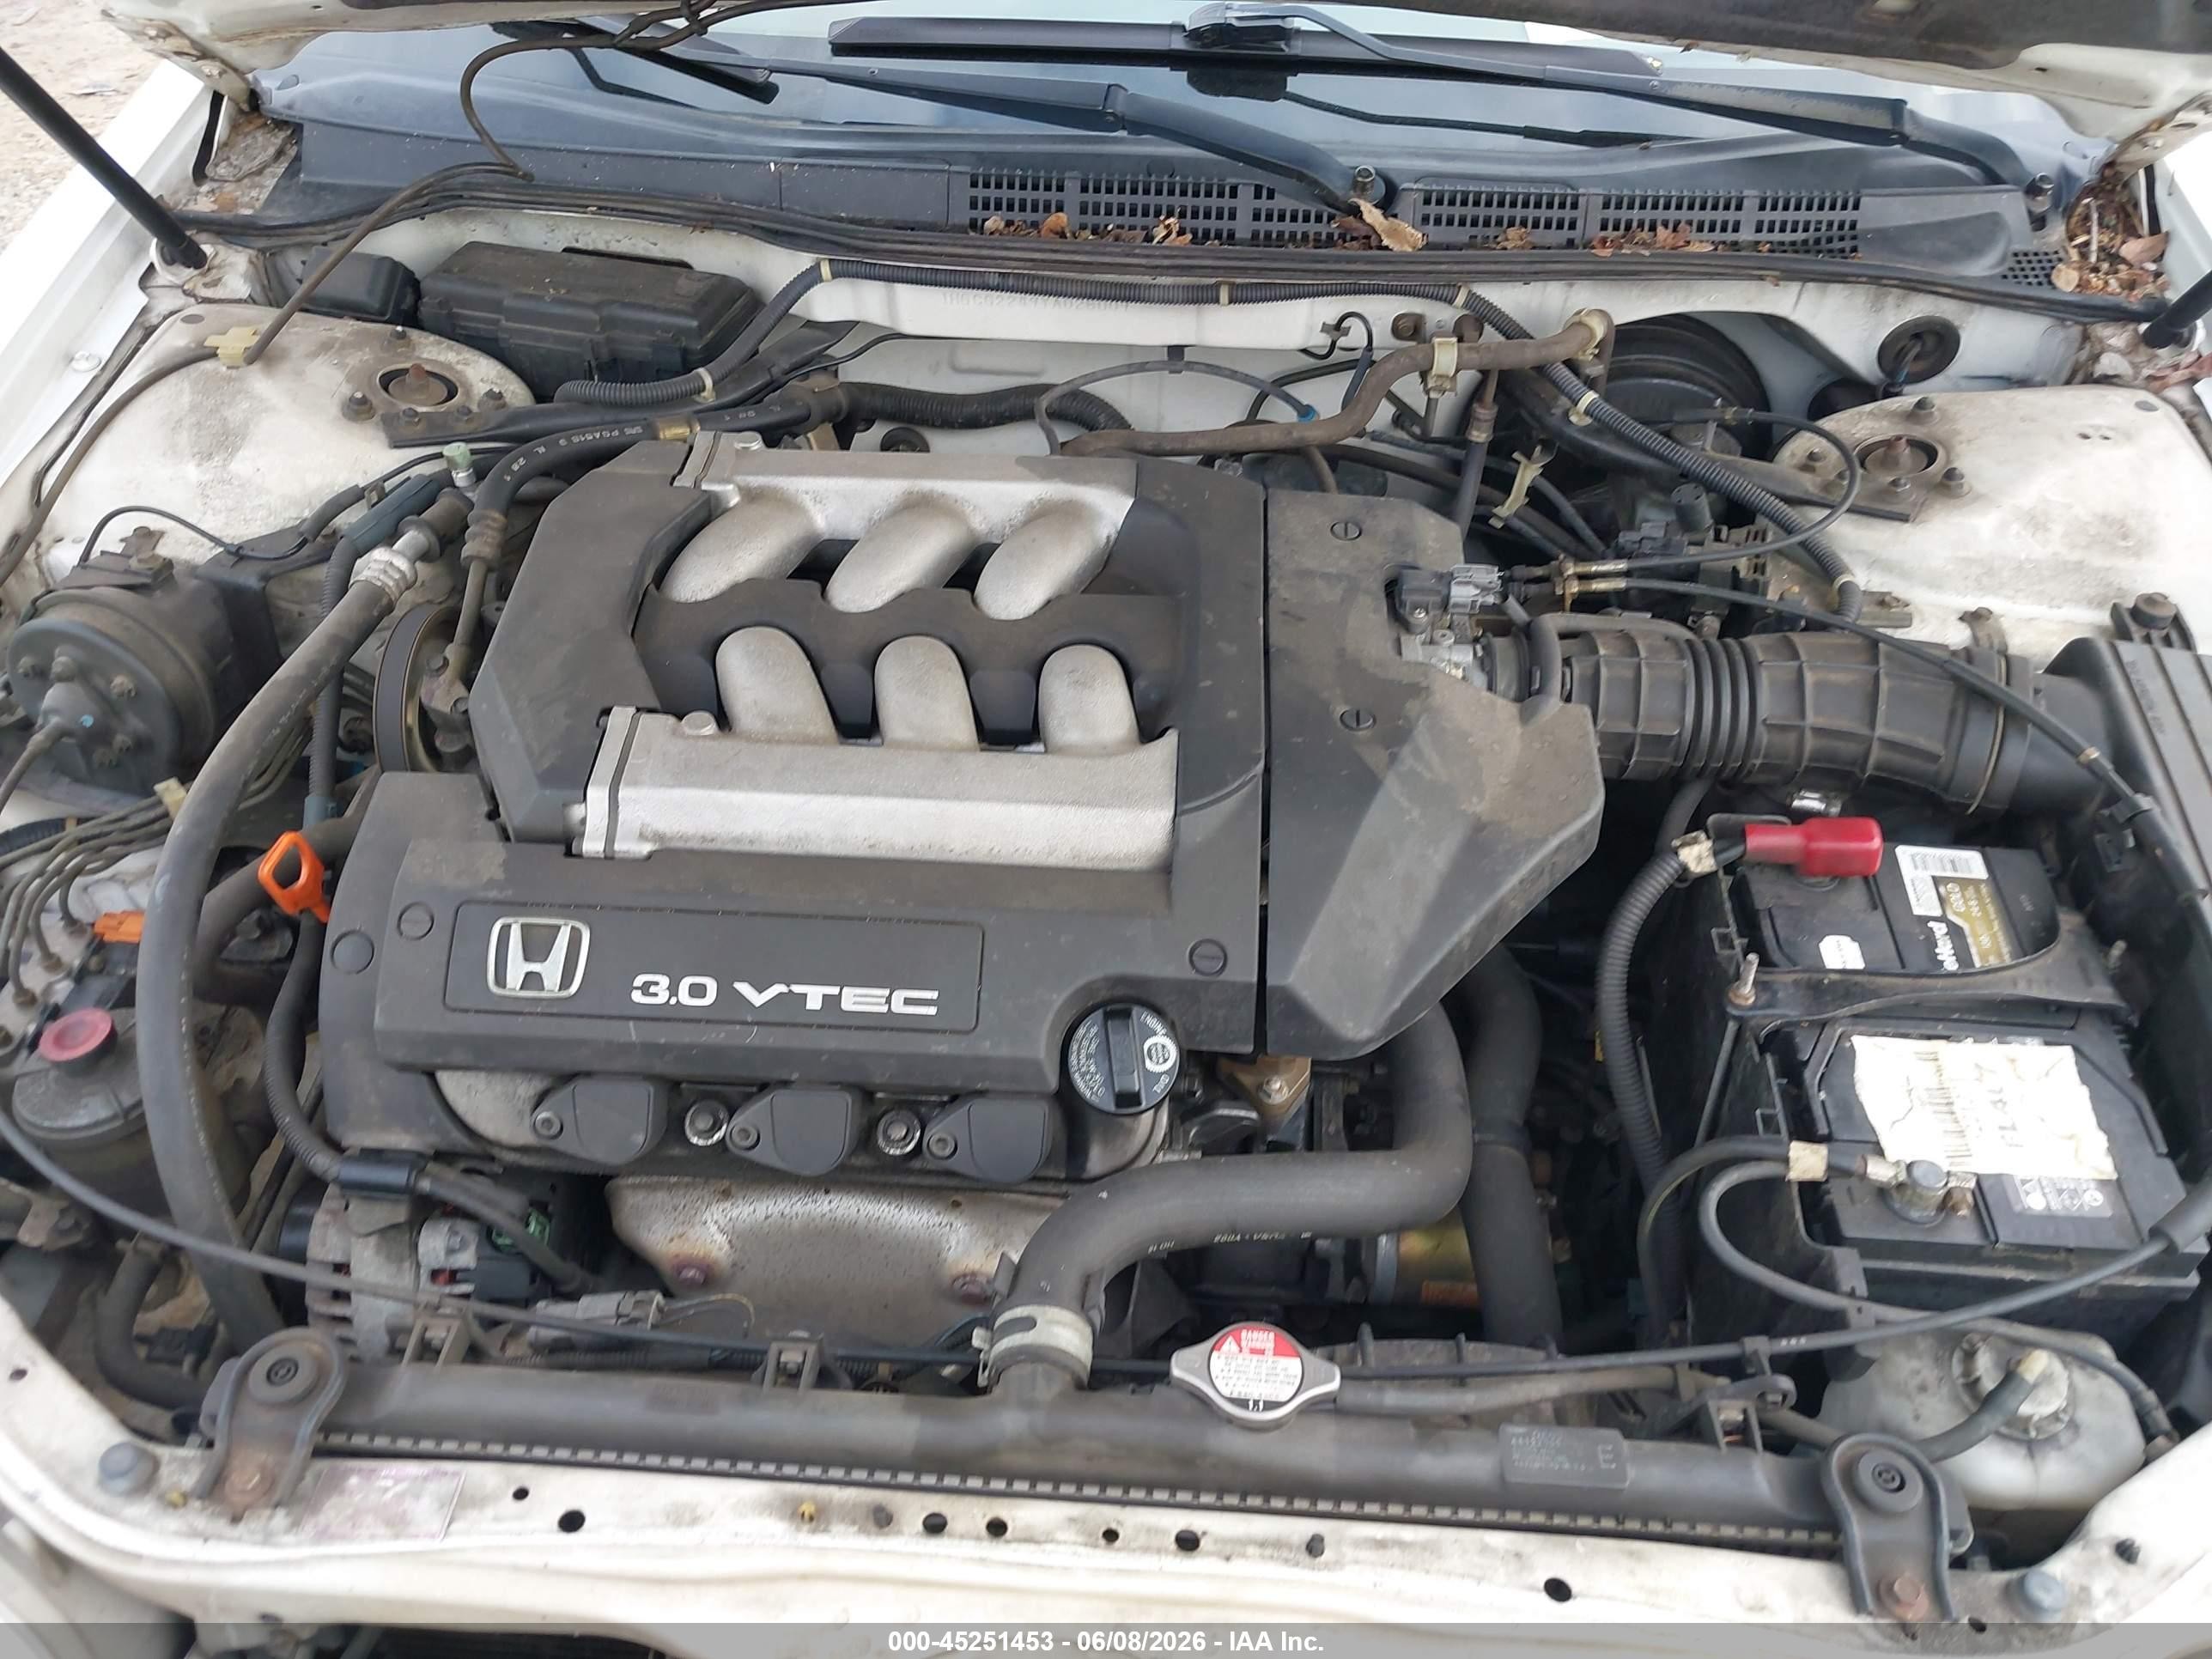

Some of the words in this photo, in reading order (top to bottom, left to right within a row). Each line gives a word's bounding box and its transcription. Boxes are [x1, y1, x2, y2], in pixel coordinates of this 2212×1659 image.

[1927, 920, 1960, 971] eHard
[630, 973, 718, 1007] 3.0
[732, 980, 939, 1017] VTEC
